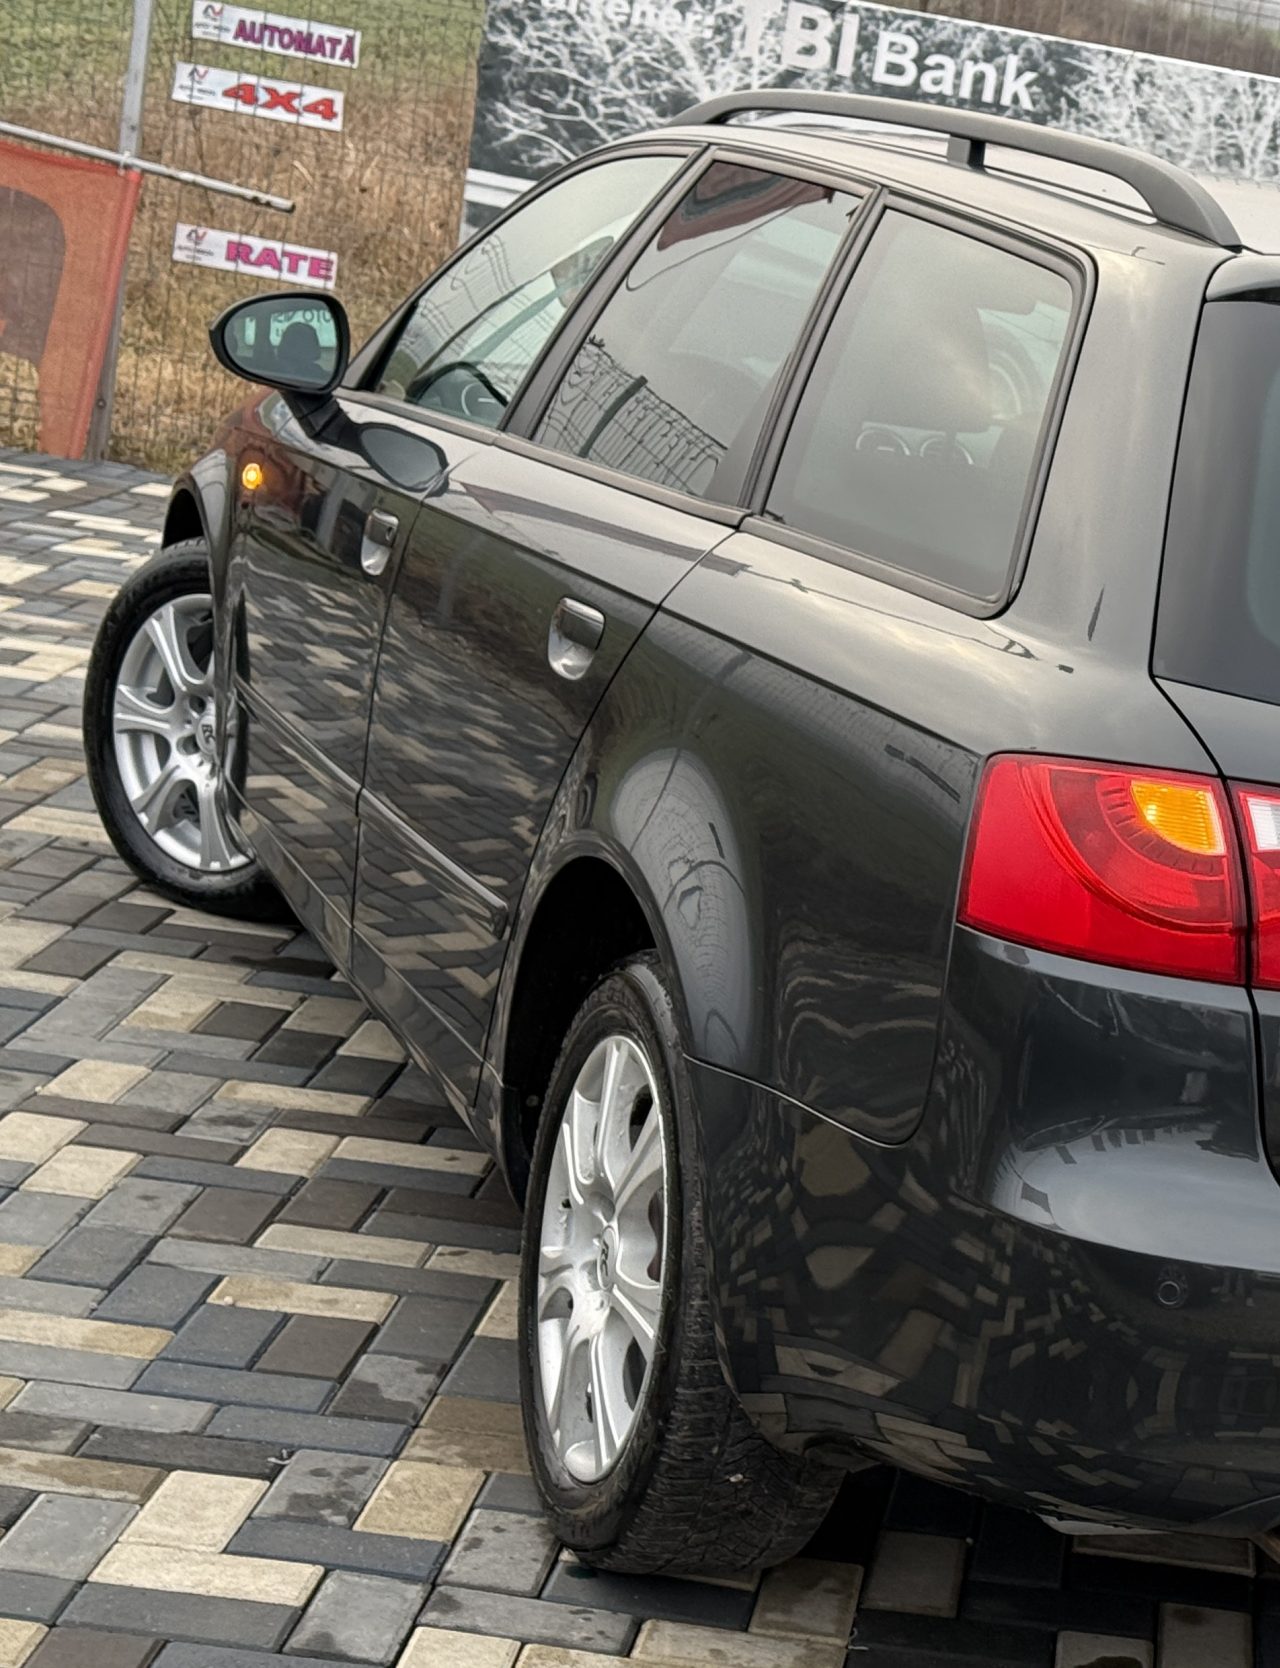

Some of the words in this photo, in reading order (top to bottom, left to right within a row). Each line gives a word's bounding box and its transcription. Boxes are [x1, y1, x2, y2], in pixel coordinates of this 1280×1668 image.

[232, 19, 357, 64] AUTOMATĂ
[871, 30, 1039, 112] Bank
[225, 240, 334, 281] RATE
